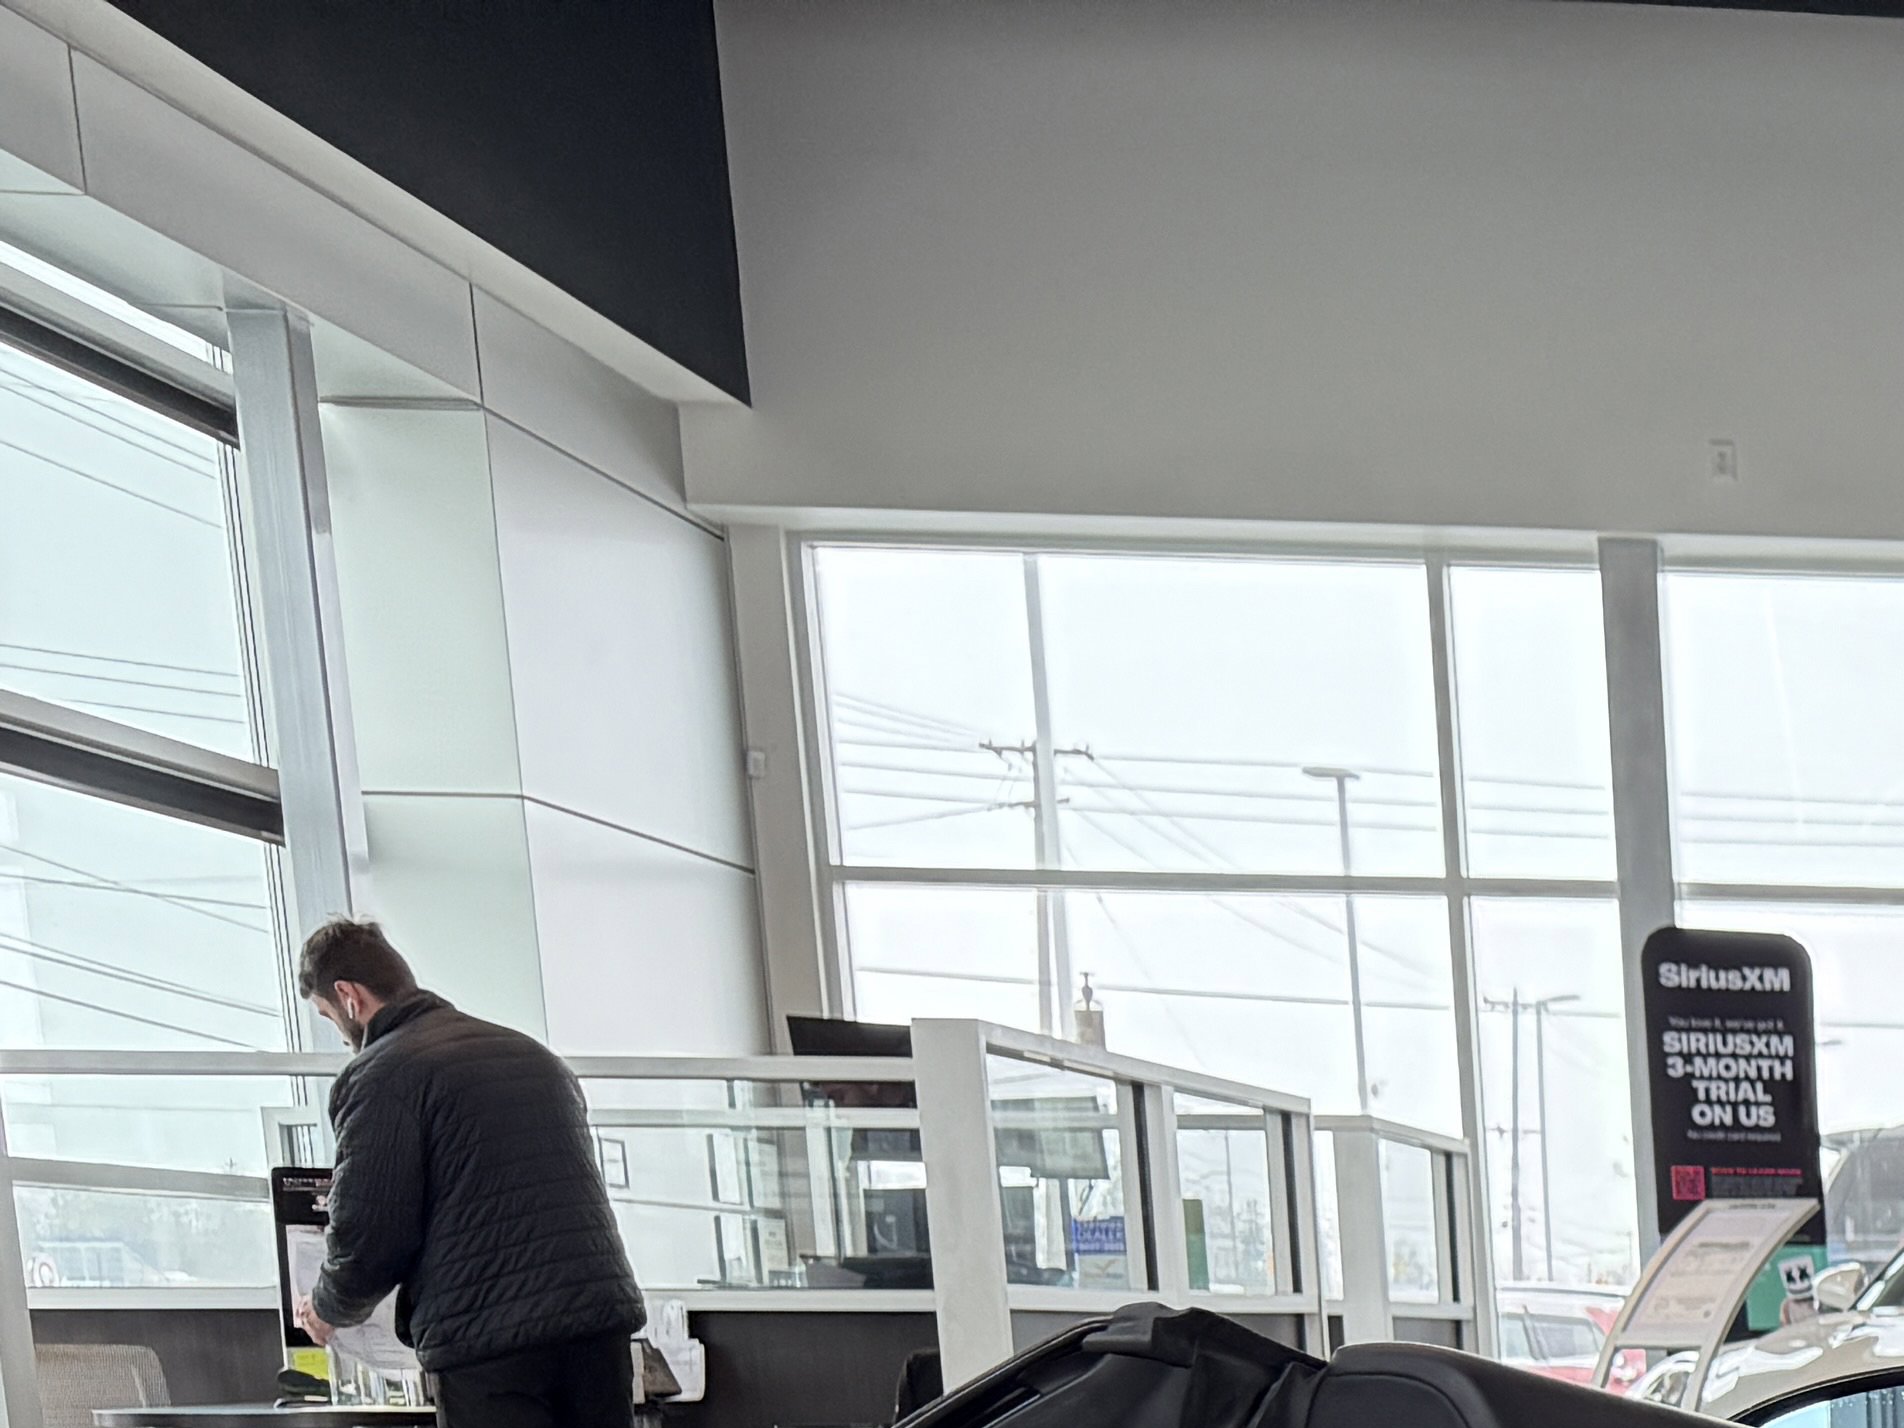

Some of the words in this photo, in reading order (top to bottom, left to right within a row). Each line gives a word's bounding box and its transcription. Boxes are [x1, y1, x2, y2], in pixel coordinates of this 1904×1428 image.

[1658, 962, 1791, 993] SiriusXM
[1663, 1031, 1794, 1057] SIRIUSXM
[1667, 1055, 1794, 1081] 3-MONTH
[1692, 1080, 1772, 1104] TRIAL
[1691, 1103, 1732, 1127] ON
[1738, 1104, 1776, 1128] US
